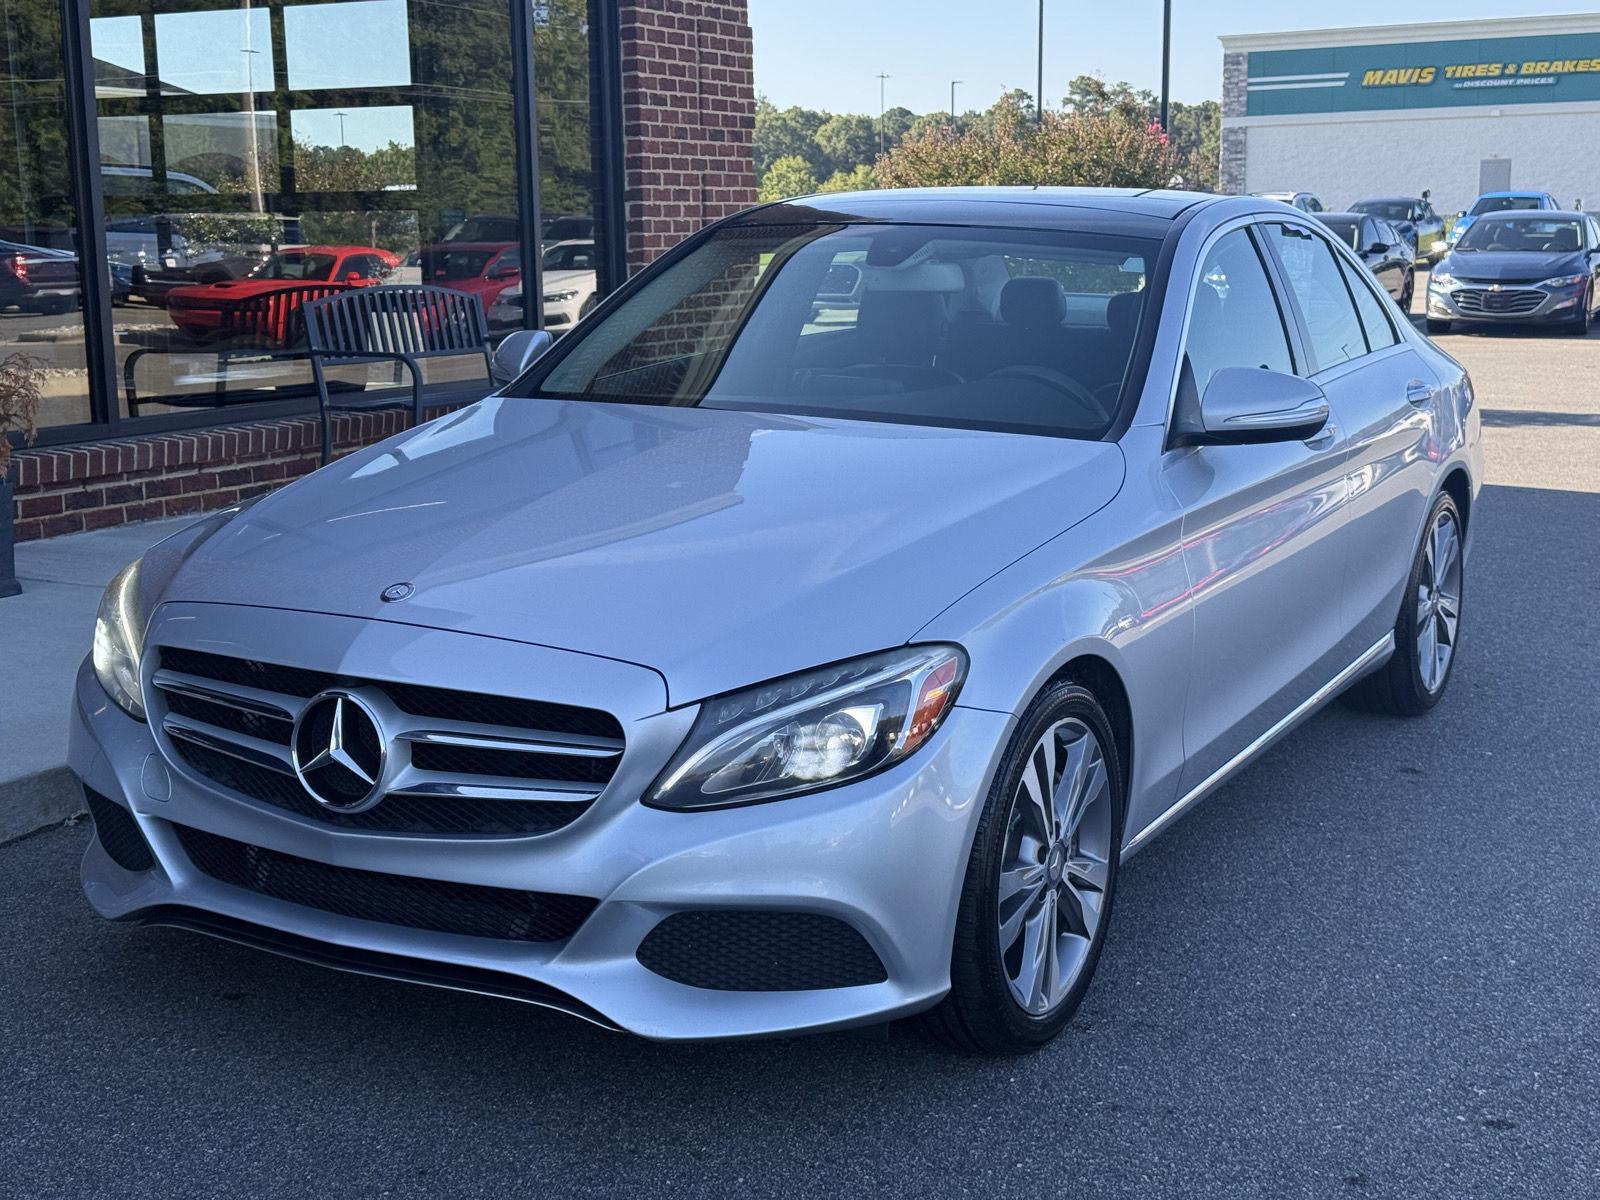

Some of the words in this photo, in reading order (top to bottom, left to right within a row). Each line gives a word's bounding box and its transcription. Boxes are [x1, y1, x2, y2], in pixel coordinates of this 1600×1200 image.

[1362, 67, 1436, 86] MAVIS
[1445, 63, 1503, 78] TIRES
[1504, 63, 1518, 75] &
[1520, 59, 1600, 75] BRAKES
[1463, 79, 1515, 88] DISCOUNT
[1516, 77, 1554, 85] PRICES
